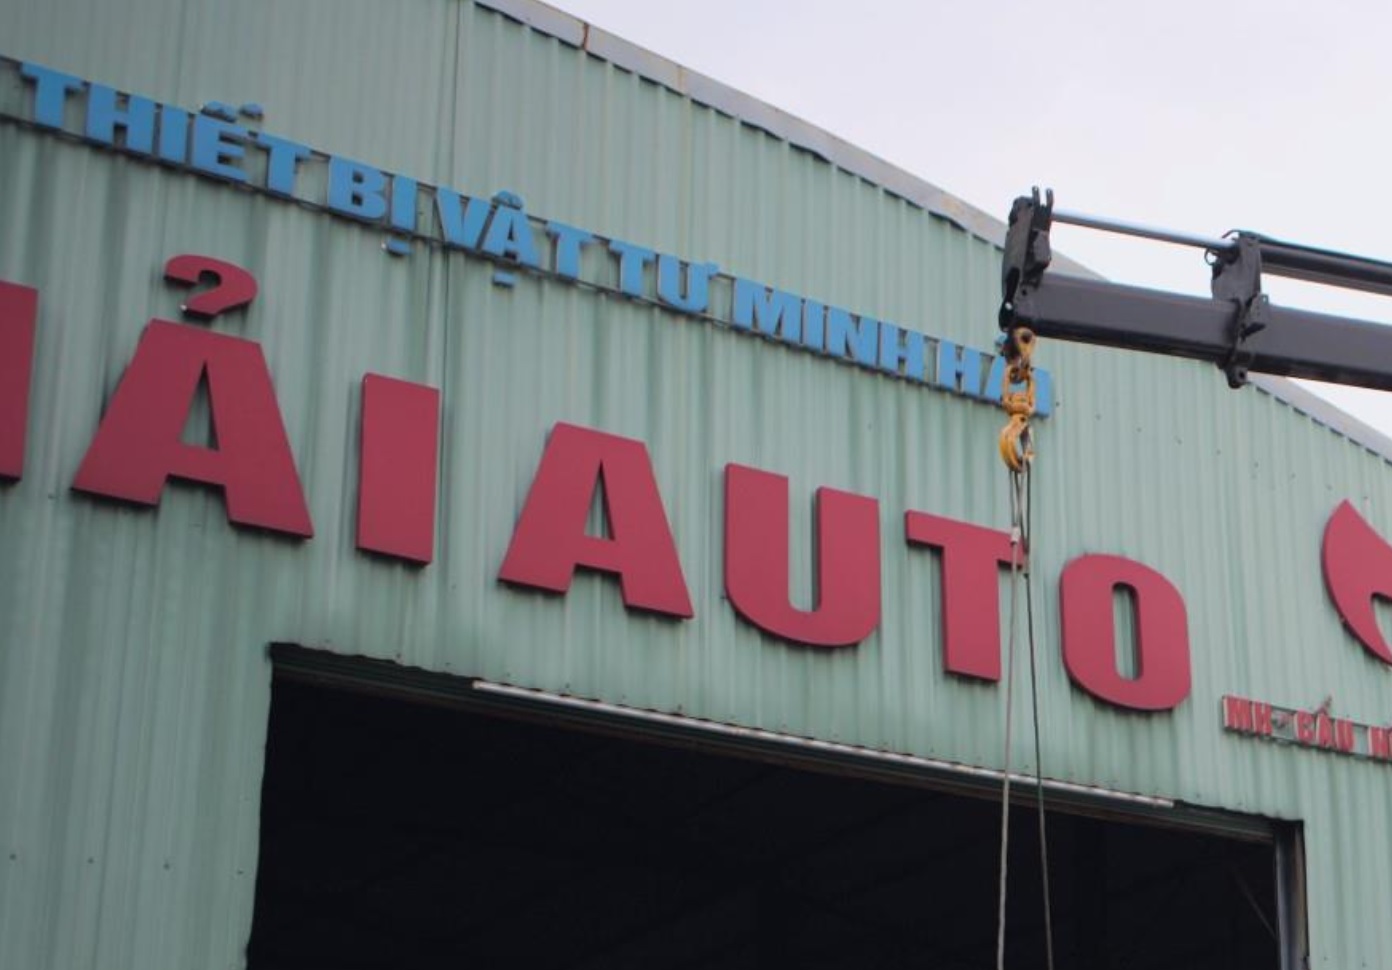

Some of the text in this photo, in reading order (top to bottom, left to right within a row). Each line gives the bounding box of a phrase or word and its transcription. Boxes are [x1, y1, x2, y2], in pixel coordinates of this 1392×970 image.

[21, 60, 312, 198] THIẾT
[328, 153, 422, 256] BỊ
[437, 188, 596, 289] VẬT
[609, 238, 718, 314] TƯ
[734, 276, 925, 380] MINH
[0, 254, 1192, 712] ẢI AUTO
